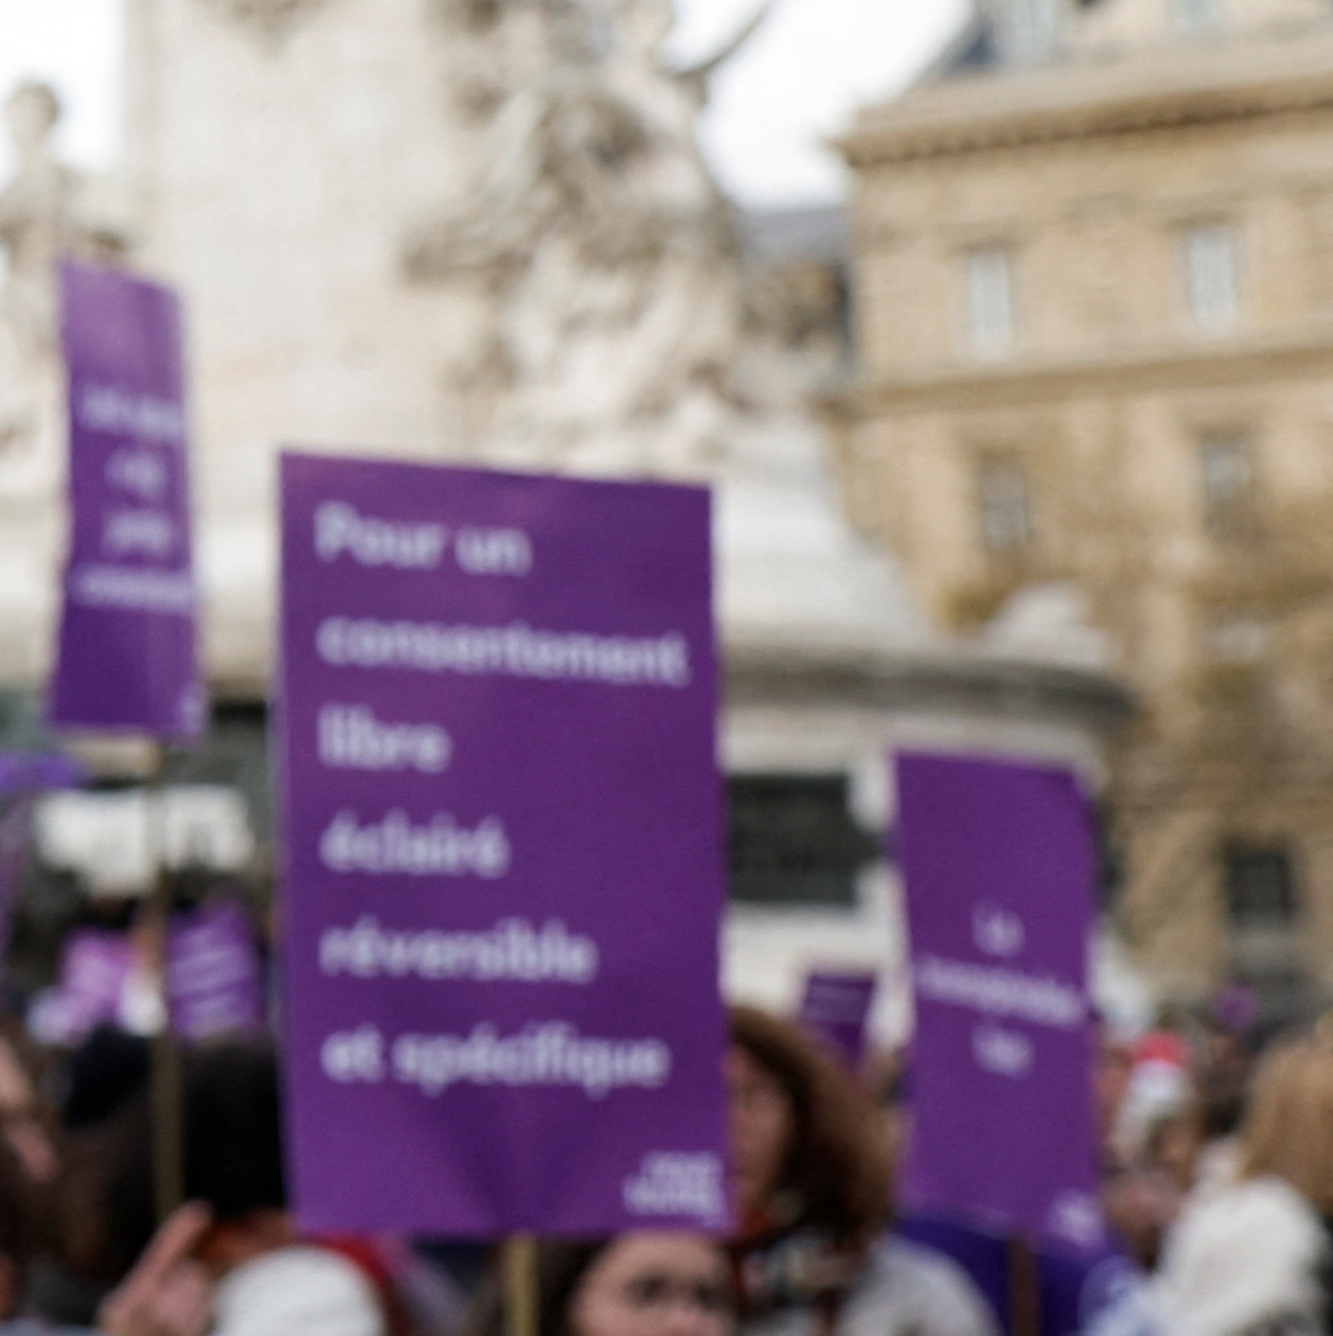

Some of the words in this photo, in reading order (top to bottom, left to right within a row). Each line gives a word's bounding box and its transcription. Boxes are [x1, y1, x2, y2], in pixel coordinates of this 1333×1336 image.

[315, 502, 445, 567] Pour
[456, 527, 530, 575] un
[317, 617, 688, 686] consentement
[319, 707, 449, 770] libre
[321, 813, 508, 876] éclairé
[320, 920, 597, 981] réversible
[321, 1028, 381, 1081] et
[393, 1021, 669, 1094] spécifique
